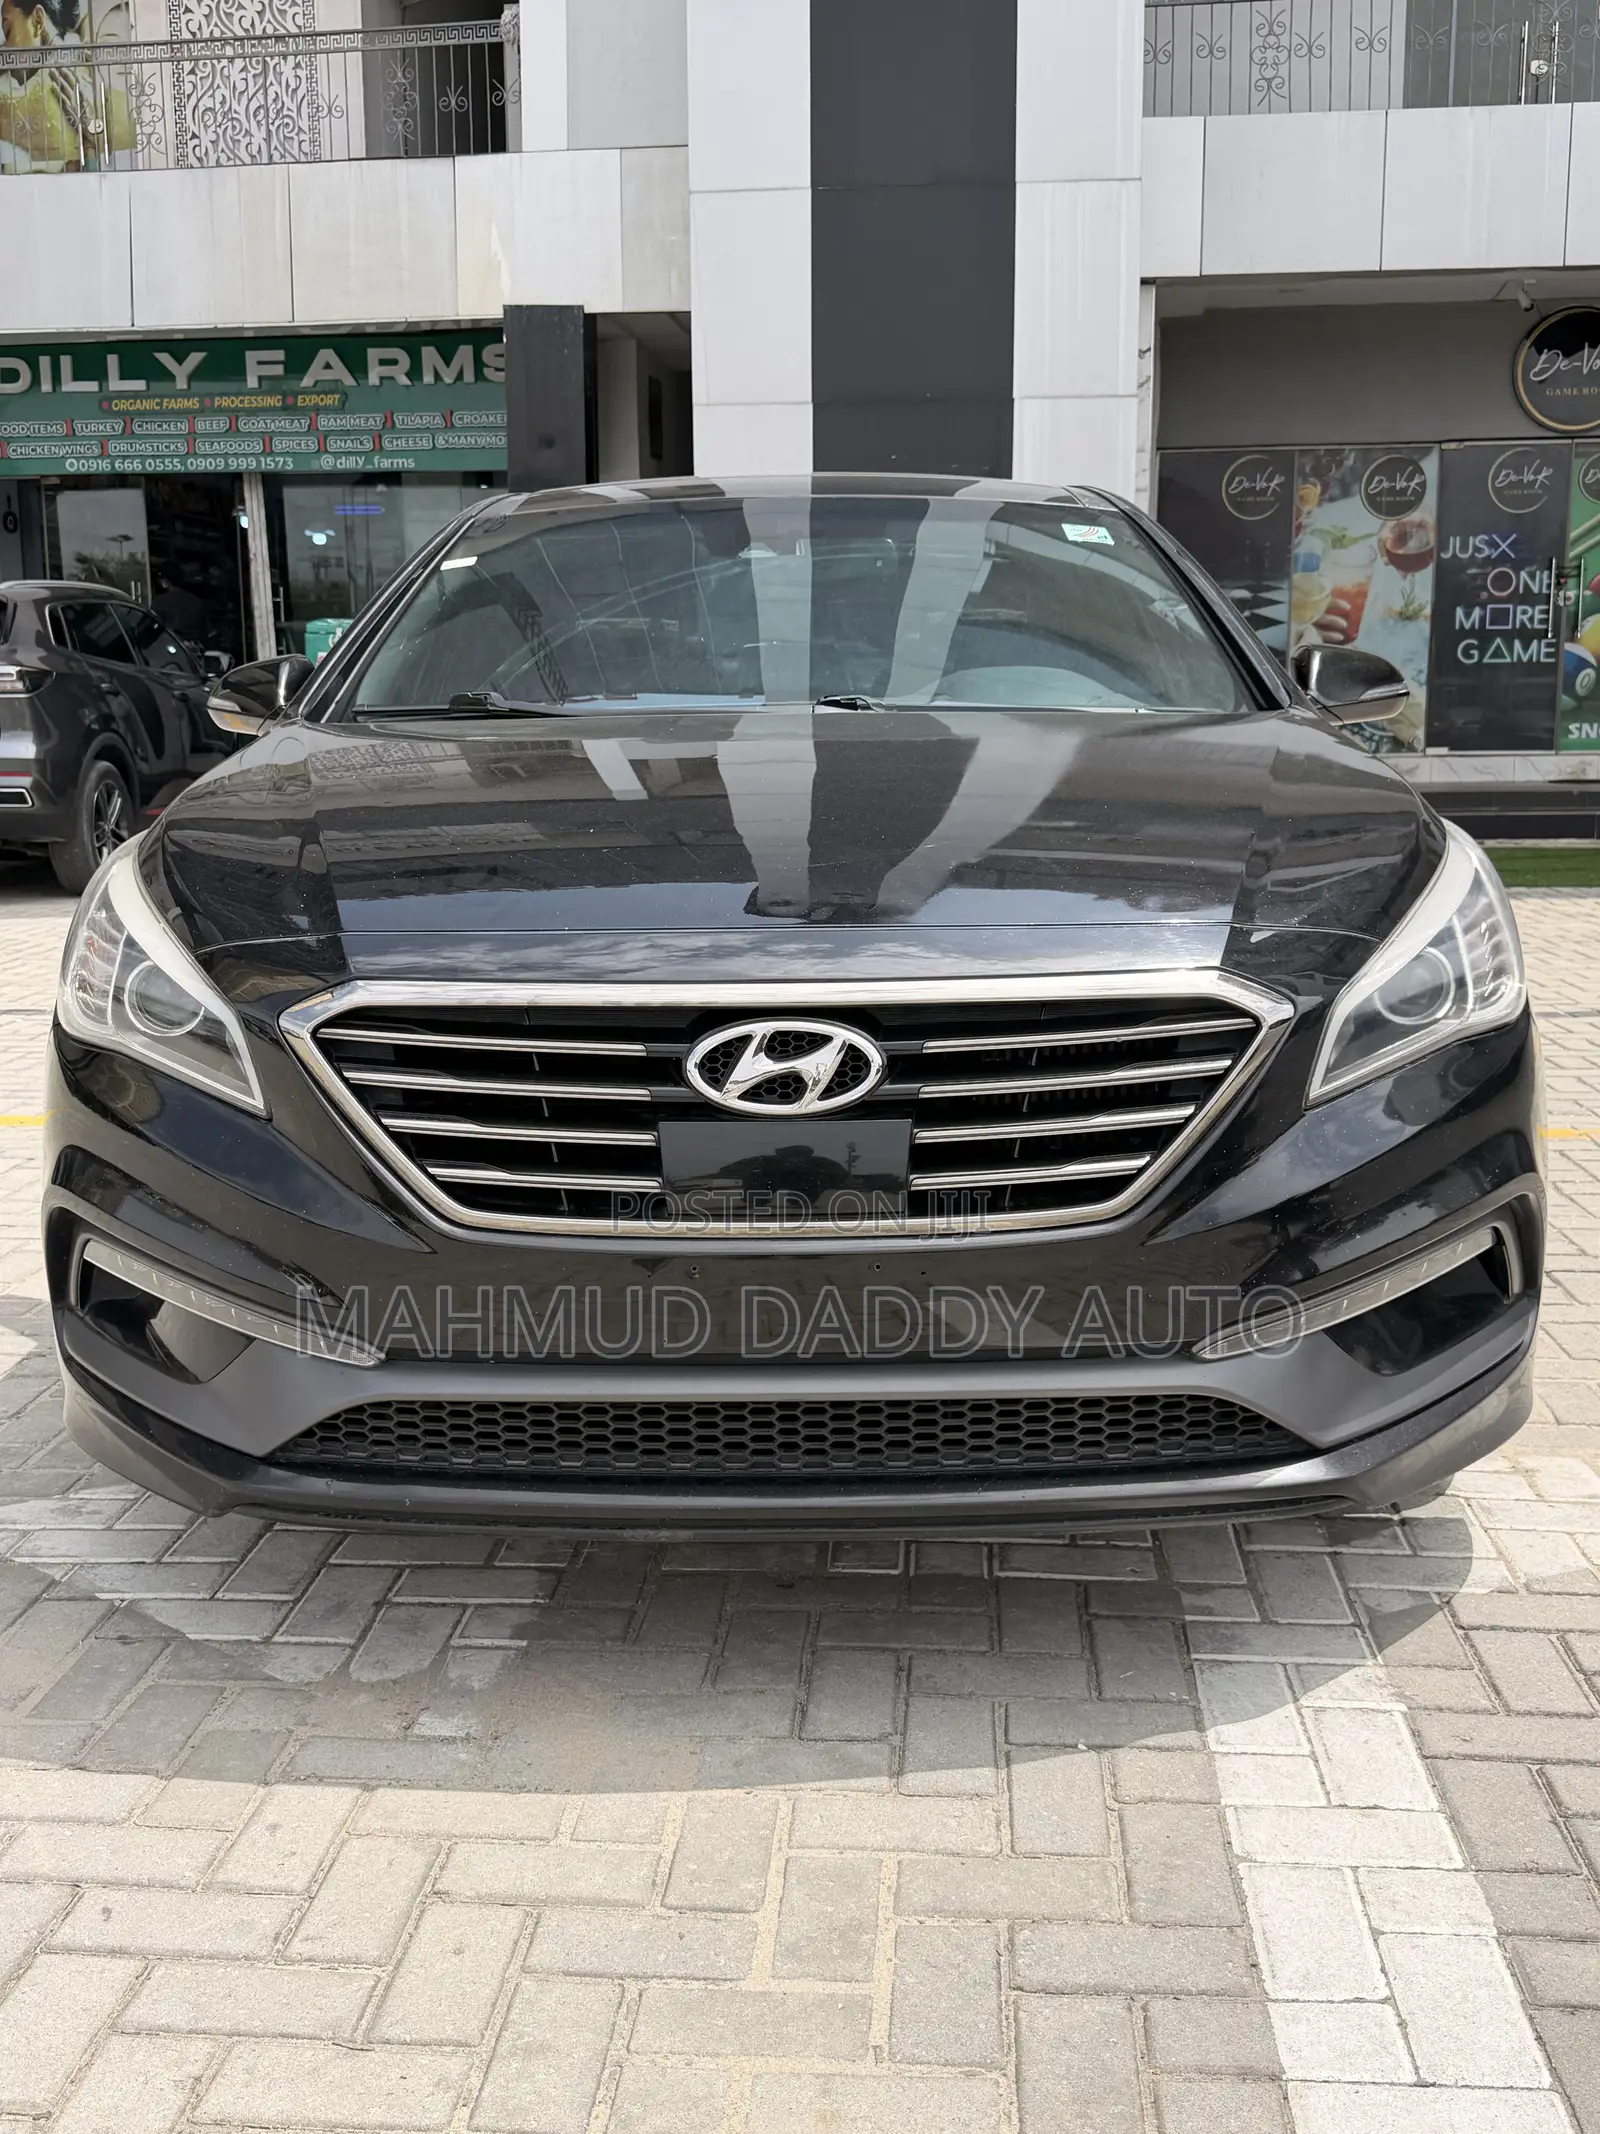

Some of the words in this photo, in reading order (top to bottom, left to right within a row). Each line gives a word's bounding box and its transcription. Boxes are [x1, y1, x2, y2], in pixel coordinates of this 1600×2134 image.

[0, 352, 208, 394] DILLY
[245, 343, 505, 389] FARMS
[1546, 387, 1580, 396] GAME
[1583, 386, 1600, 395] RO
[111, 399, 161, 411] ORGANIC
[162, 398, 200, 409] FARMS
[214, 395, 283, 408] PROCESSING
[297, 394, 341, 406] EXPORT
[240, 419, 272, 430] GOAT
[275, 418, 308, 429] MEAT
[320, 418, 347, 428] RAM
[350, 416, 383, 427] MEAT
[397, 414, 441, 426] TILAPIA
[455, 413, 507, 424] CROAKE
[0, 424, 28, 434] OOD
[30, 423, 65, 434] ITEMS
[75, 422, 121, 433] TURKEY
[134, 420, 186, 432] CHICKEN
[198, 420, 227, 430] BEEF
[199, 440, 260, 452] SEAFOODS
[275, 439, 317, 450] SPICES
[329, 438, 370, 449] SNAILS
[384, 437, 429, 448] CHEESE
[448, 435, 482, 446] MANY
[486, 434, 507, 446] MO
[9, 444, 59, 456] CHICKEN
[61, 442, 99, 454] WINGS
[111, 440, 185, 453] DRUMSTICKS
[79, 459, 112, 472] 0916
[115, 458, 142, 471] 666
[145, 458, 185, 472] 0555,
[187, 457, 225, 471] 0909
[228, 456, 257, 470] 999
[260, 456, 294, 470] 1573
[320, 454, 416, 470] @dilly_farms
